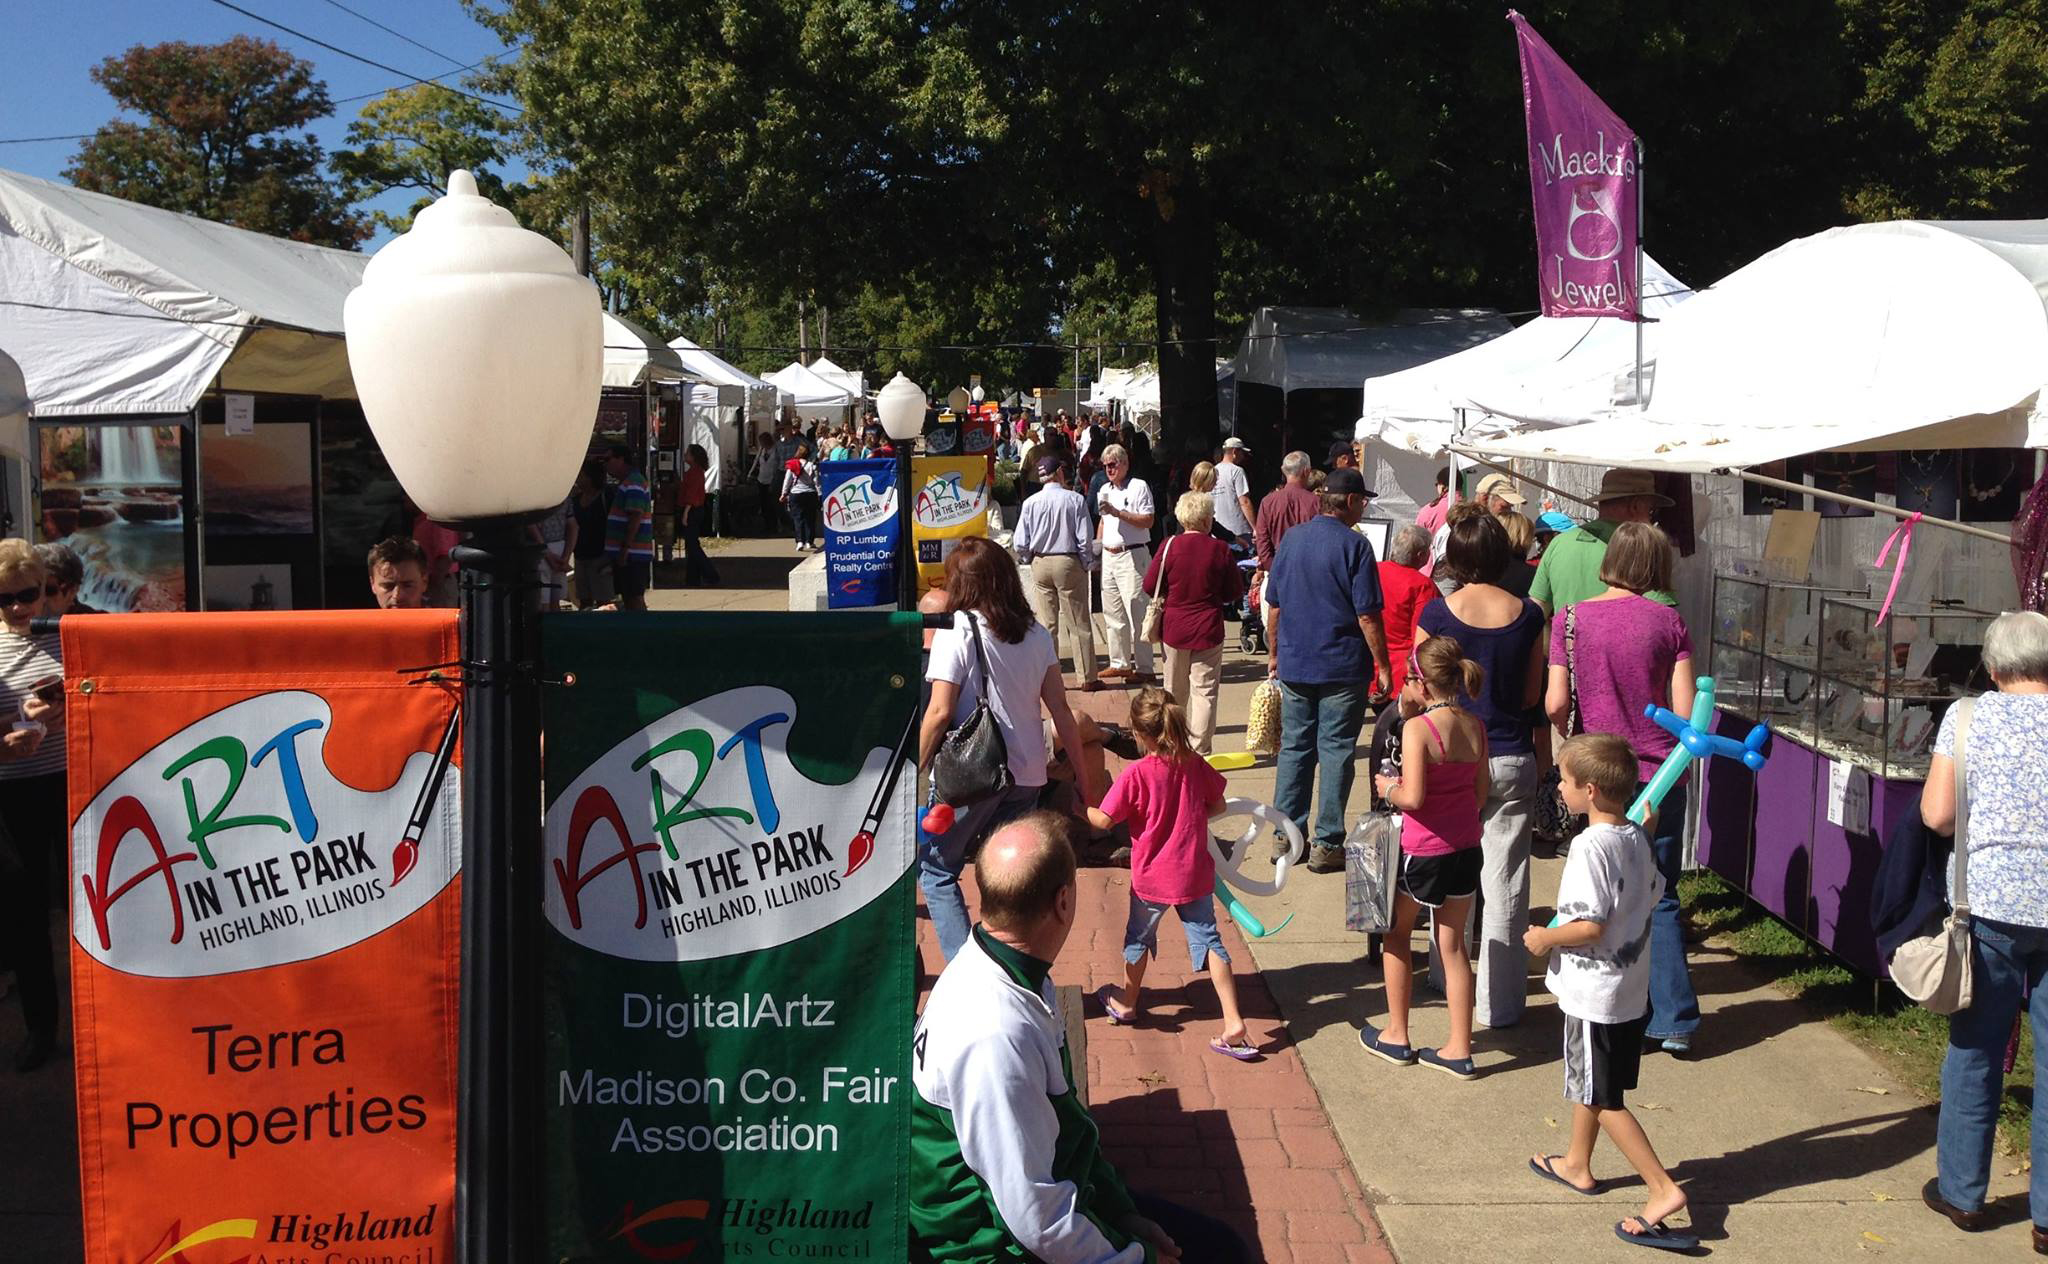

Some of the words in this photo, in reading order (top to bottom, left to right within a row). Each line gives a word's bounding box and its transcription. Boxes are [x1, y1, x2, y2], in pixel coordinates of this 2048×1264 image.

[1538, 131, 1635, 185] Mackie
[825, 480, 871, 526] ART
[852, 508, 865, 519] THE
[865, 503, 881, 516] PARK
[915, 476, 961, 522] ART
[942, 504, 954, 515] THE
[954, 499, 971, 511] PARK
[830, 550, 875, 561] Prudential
[836, 536, 851, 545] RP
[853, 534, 888, 544] Lumber
[833, 563, 862, 573] Realty
[82, 718, 324, 951] ART
[553, 712, 789, 930] ART
[184, 876, 223, 922] IN
[224, 856, 288, 909] THE
[290, 831, 376, 890] PARK
[648, 867, 683, 910] IN
[685, 848, 748, 899] THE
[751, 824, 834, 881] PARK
[200, 903, 305, 951] HIGHLAND,
[306, 878, 386, 919] ILLINOIS
[661, 894, 762, 939] HIGHLAND,
[764, 869, 841, 910] ILLINOIS
[623, 993, 835, 1038] DigitalArtz
[192, 1024, 345, 1075] Terra
[559, 1069, 725, 1106] Madison
[739, 1068, 806, 1104] Co.
[822, 1066, 898, 1104] Fair
[126, 1087, 427, 1159] Properties
[610, 1115, 838, 1152] Association
[267, 1203, 437, 1250] Highland
[720, 1197, 874, 1235] Highland
[768, 1238, 871, 1258] Council
